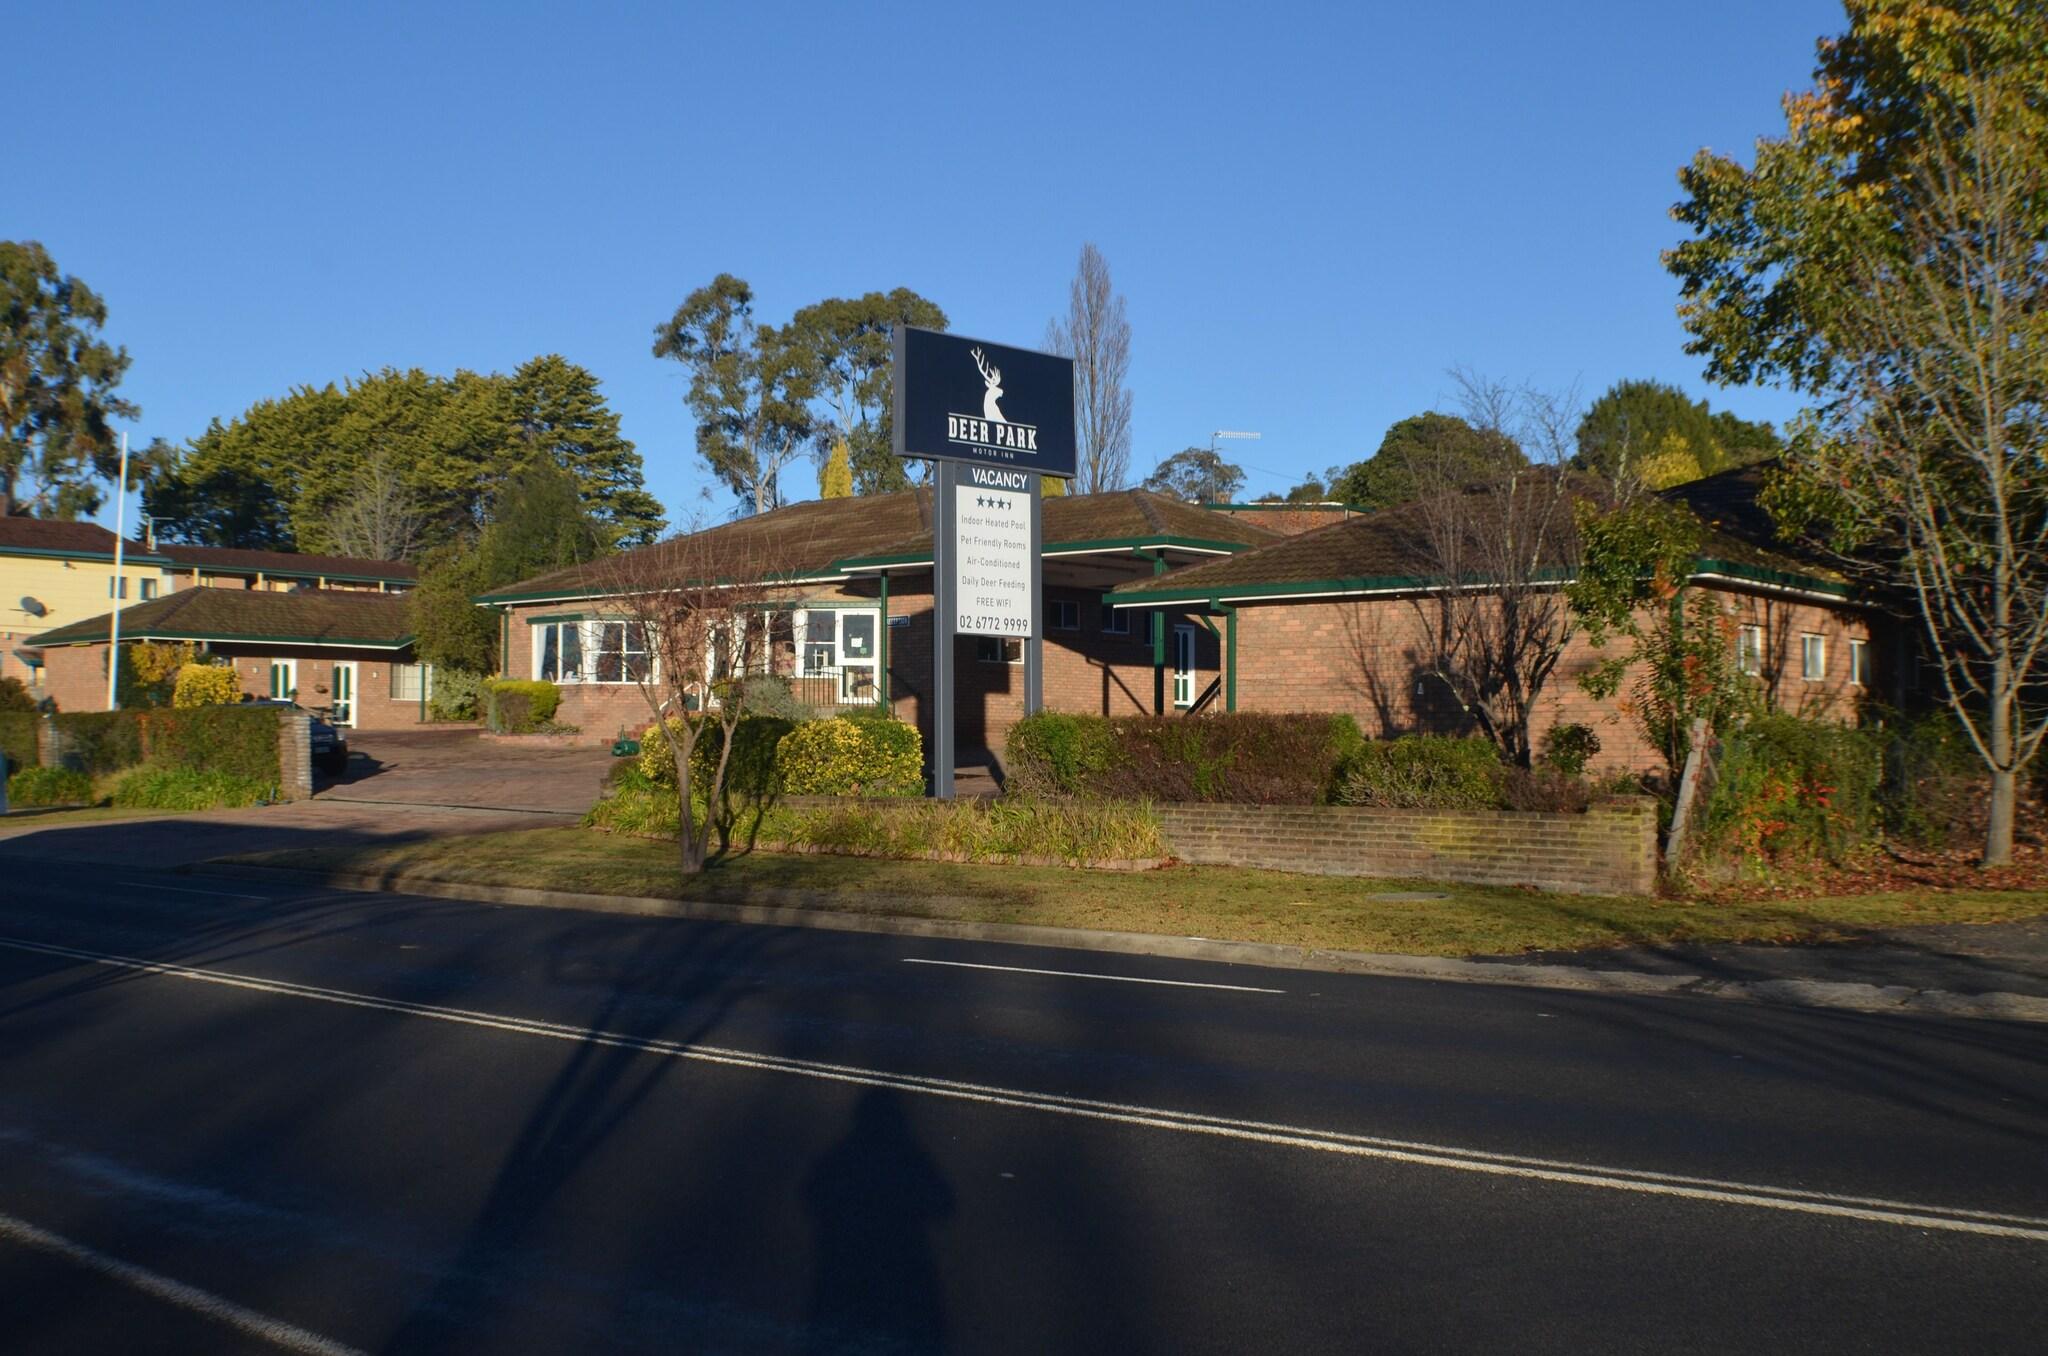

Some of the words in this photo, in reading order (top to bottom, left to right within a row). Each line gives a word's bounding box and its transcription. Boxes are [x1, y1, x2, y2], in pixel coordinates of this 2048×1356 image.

[948, 417, 989, 443] DEER
[996, 424, 1037, 450] PARK
[972, 447, 997, 457] MOTOR
[1001, 452, 1014, 460] INN
[972, 468, 1027, 489] VACANCY
[961, 514, 983, 526] Indoor
[985, 517, 1009, 529] Heated
[1010, 520, 1026, 531] Pool
[961, 535, 972, 545] Pet
[974, 536, 1002, 549] Friendly
[1003, 540, 1026, 551] Rooms
[967, 556, 1020, 569] Air-Conditioned
[962, 575, 979, 588] Daily
[981, 577, 997, 588] Deer
[999, 579, 1026, 592] Feeding
[976, 597, 994, 608] FREE
[996, 599, 1012, 609] WIFI
[960, 615, 972, 629] 02
[975, 616, 1000, 631] 6772
[1003, 617, 1028, 632] 9999
